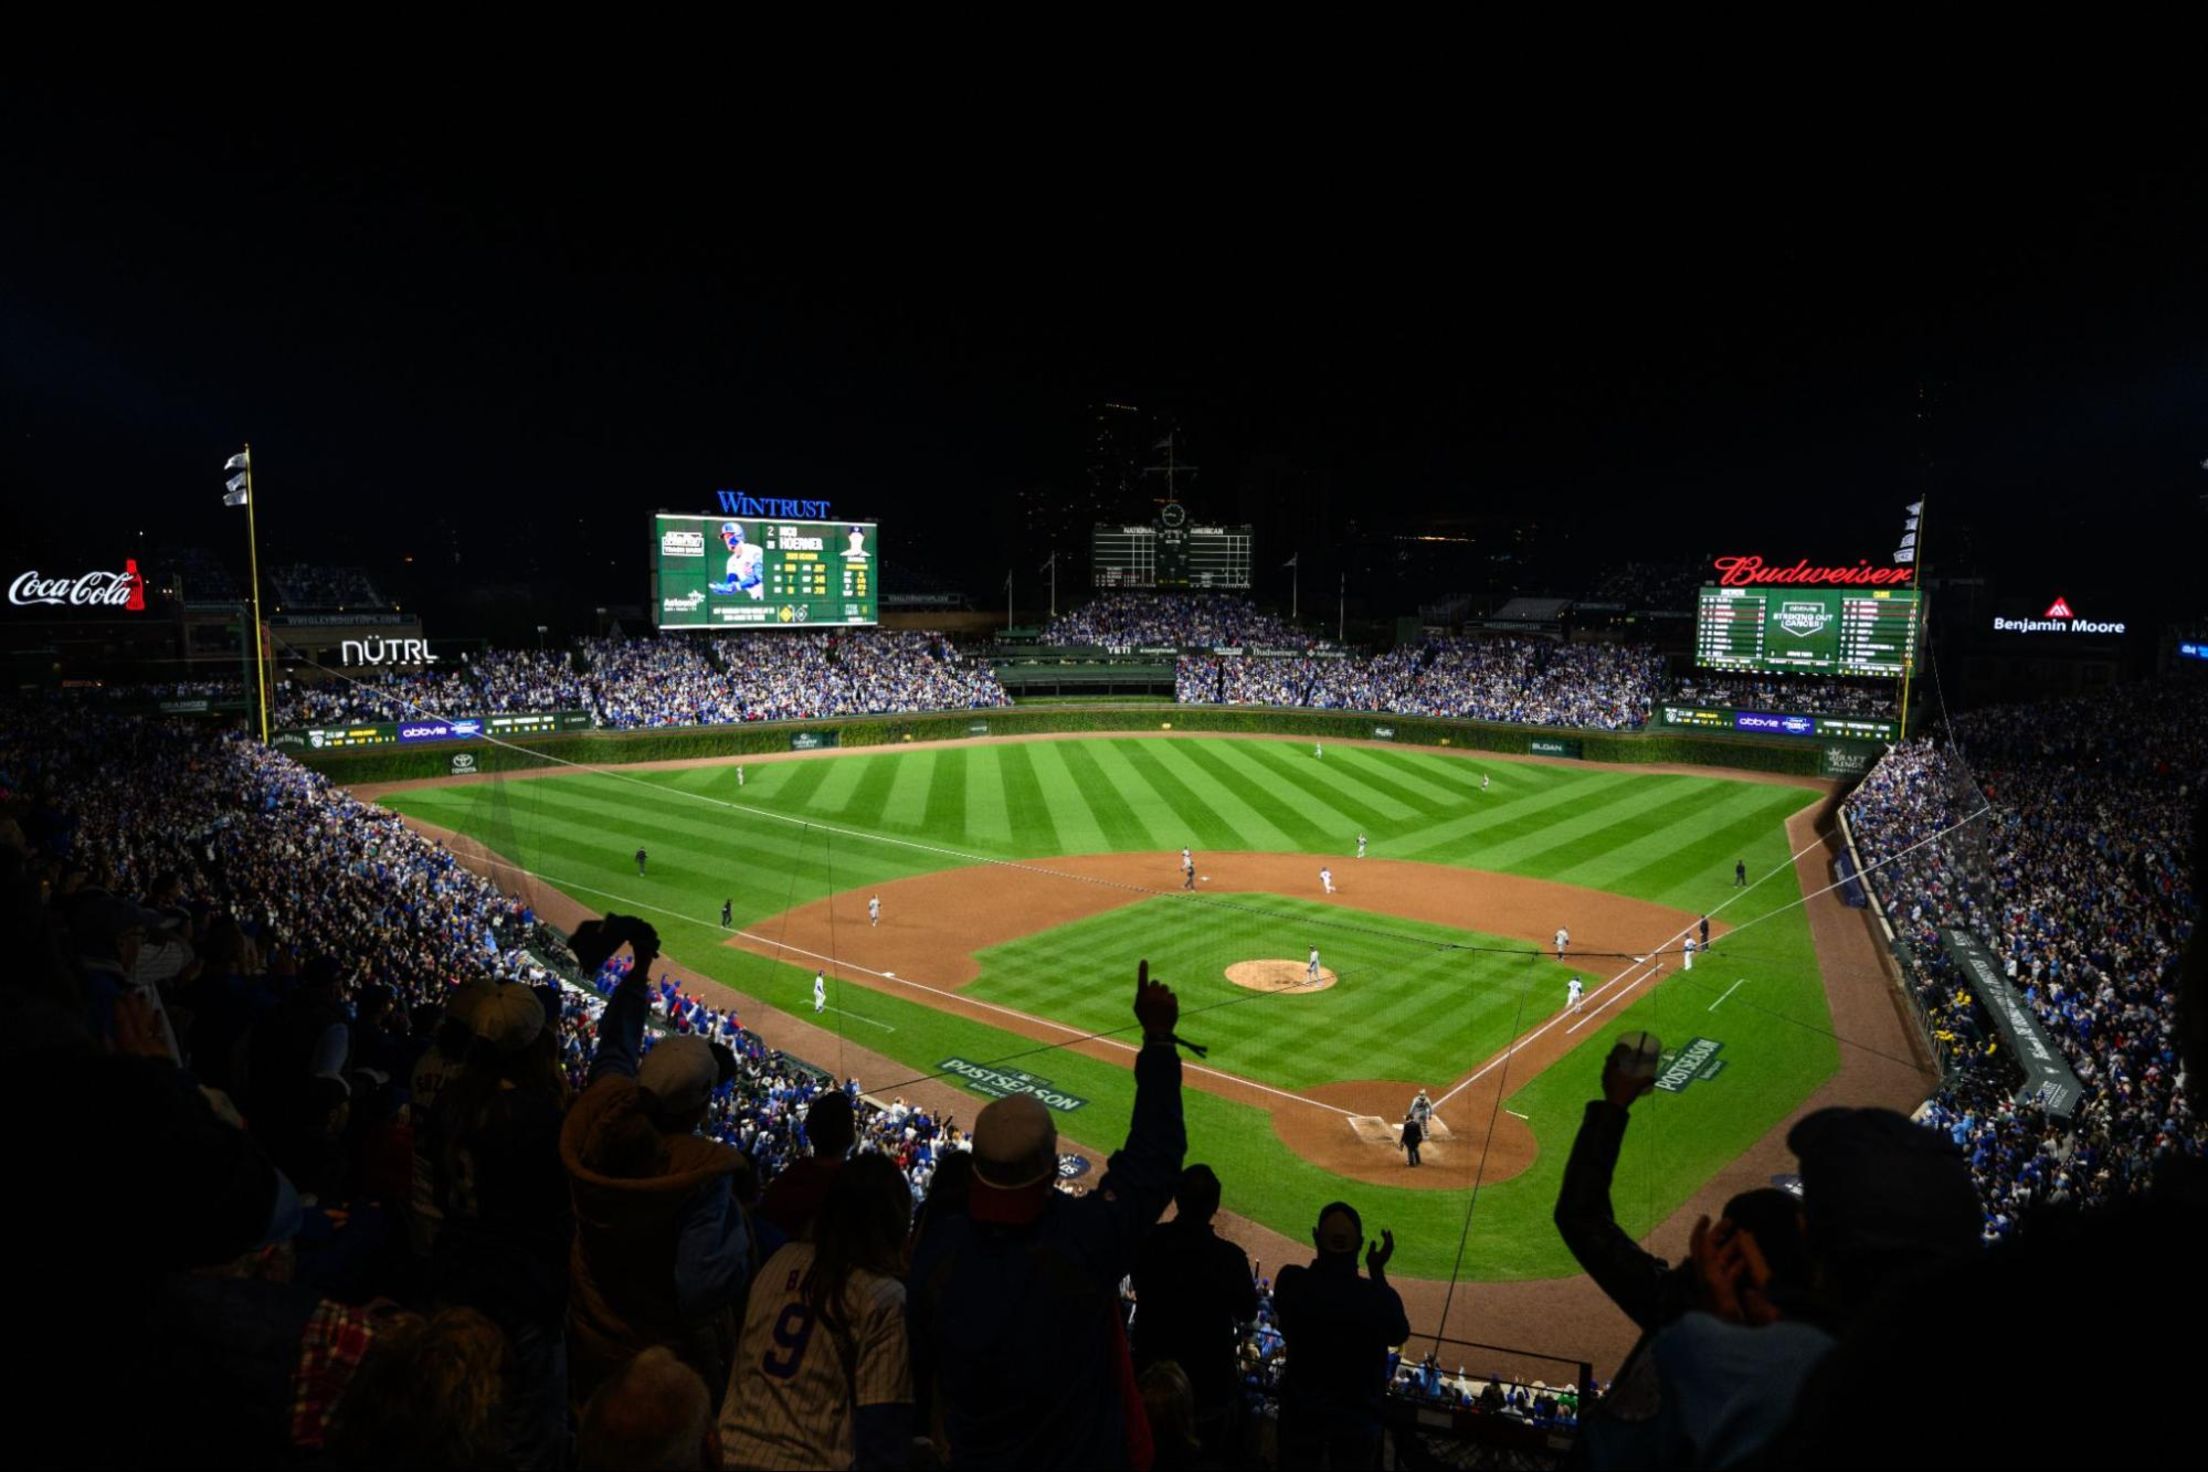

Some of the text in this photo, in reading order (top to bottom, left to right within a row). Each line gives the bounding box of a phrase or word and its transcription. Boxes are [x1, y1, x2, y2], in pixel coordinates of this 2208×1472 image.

[767, 526, 775, 536] 2
[1714, 556, 1913, 586] Budweiser
[8, 570, 133, 606] Coca-Cola
[1994, 617, 2126, 633] Benjamin Moore
[402, 726, 447, 739] abbvie
[1654, 1038, 1721, 1091] POSTSEASON
[941, 1059, 1082, 1111] POSTSEASON
[762, 1302, 816, 1379] 9
